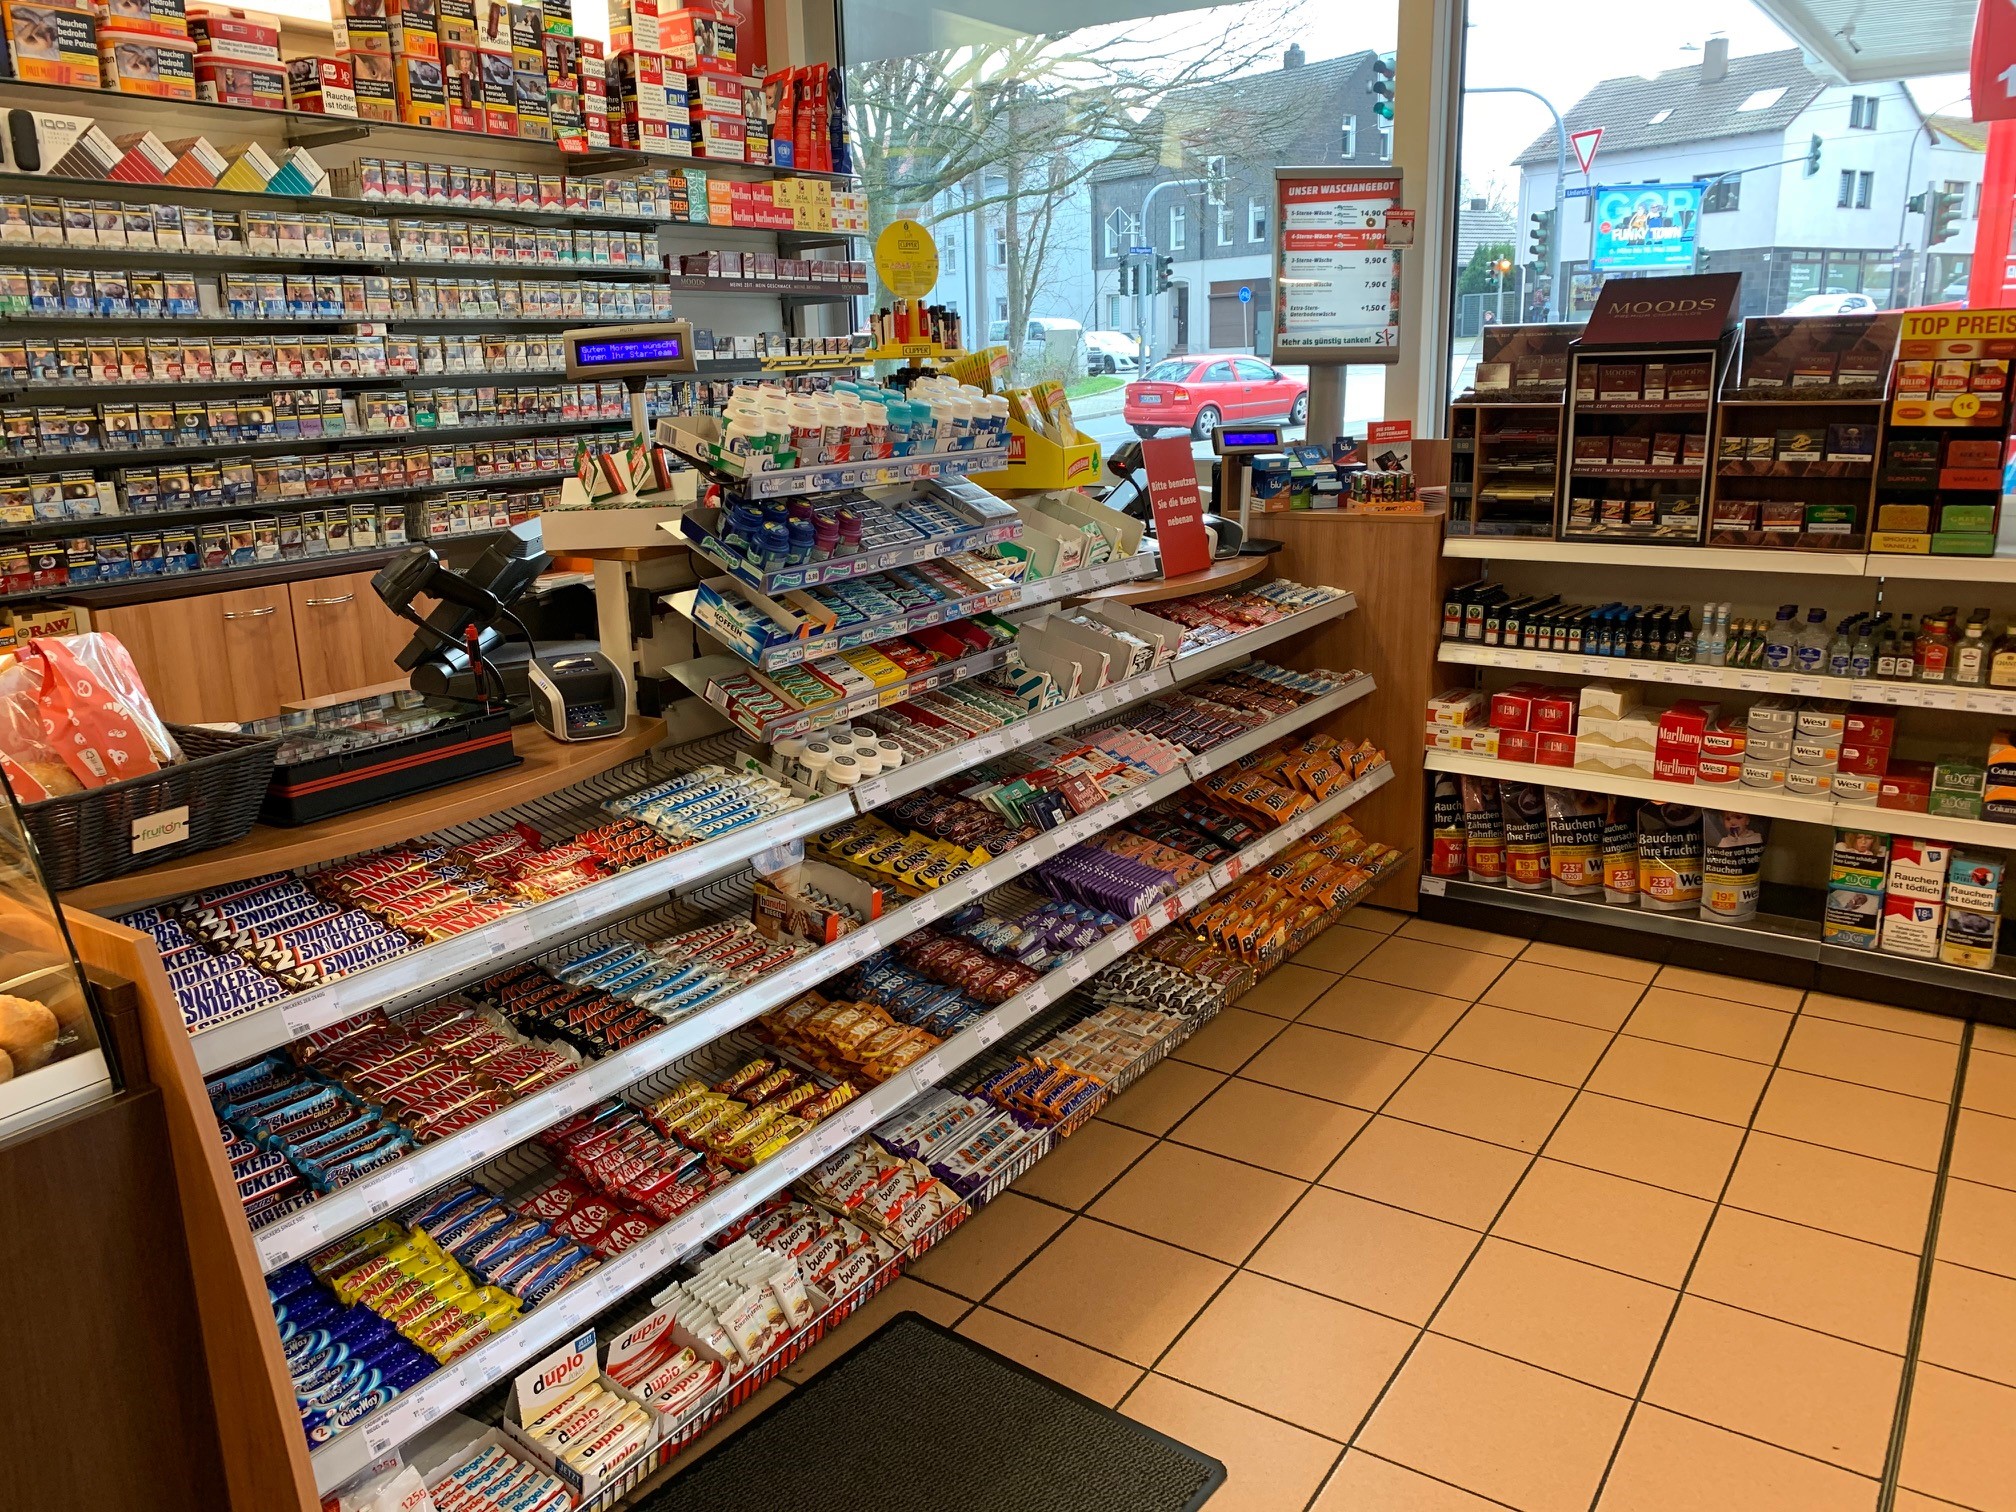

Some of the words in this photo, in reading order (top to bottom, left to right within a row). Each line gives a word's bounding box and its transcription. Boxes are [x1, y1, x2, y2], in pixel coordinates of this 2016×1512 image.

[57, 18, 87, 29] Rauchen
[58, 29, 86, 39] bedroht
[59, 38, 75, 47] Ihre
[158, 59, 183, 68] bedroht
[1288, 184, 1318, 196] UNSER
[1321, 182, 1395, 194] WASCHANGEBOT
[1612, 228, 1647, 241] FUNKY
[1651, 227, 1682, 238] TOWN
[1364, 257, 1381, 265] 9,90
[1364, 281, 1381, 289] 7,90
[1609, 298, 1716, 314] MOODS
[1909, 317, 1950, 335] TOP
[1956, 316, 2016, 334] PREIS
[610, 344, 638, 352] Morgen
[1314, 337, 1342, 346] günstig
[1344, 336, 1372, 344] tanken!
[630, 350, 672, 358] Star-Team
[1151, 482, 1167, 491] Bitte
[1168, 478, 1196, 489] benutzen
[1270, 480, 1281, 489] blu
[1158, 500, 1167, 509] Sie
[1169, 498, 1179, 508] die
[1180, 496, 1196, 505] Kasse
[1168, 515, 1193, 526] nebenan
[29, 618, 70, 636] RAW
[714, 612, 743, 637] KOFFEIN
[1659, 727, 1700, 744] Marlboro
[1707, 737, 1730, 747] West
[1655, 759, 1696, 776] Marlboro
[1702, 763, 1725, 773] West
[627, 777, 686, 803] BOUNTY
[659, 782, 721, 808] BOUNTY
[1837, 779, 1862, 790] West
[679, 789, 737, 817] BOUNTY
[691, 799, 748, 824] BOUNTY
[142, 821, 181, 841] fruiton
[820, 821, 858, 844] CORNY
[1467, 821, 1492, 829] Zähne
[1550, 819, 1595, 831] Rauchen
[842, 833, 879, 856] CORNY
[1507, 832, 1523, 841] Ihre
[1552, 833, 1572, 844] Ihre
[1639, 833, 1684, 844] Rauchen
[868, 842, 905, 865] CORNY
[893, 848, 932, 873] CORNY
[1640, 845, 1661, 857] Ihre
[1706, 856, 1736, 865] werden
[1738, 857, 1746, 865] oft
[1707, 847, 1732, 857] Kinder
[1734, 848, 1744, 856] von
[334, 850, 420, 886] TWIX
[1705, 864, 1742, 875] Rauchern
[352, 869, 436, 902] TWIX
[1890, 881, 1903, 889] ist
[1905, 883, 1940, 895] tödlich
[1894, 872, 1939, 886] Rauchen
[222, 880, 306, 917] SNICKERS
[378, 883, 459, 918] TWIX
[1134, 884, 1161, 915] Milka
[1951, 886, 1993, 899] Rauchen
[1961, 896, 1994, 908] tödlich
[236, 893, 318, 929] SNICKERS
[257, 902, 341, 940] SNICKERS
[764, 908, 782, 918] RIEGEL
[283, 910, 368, 950] SNICKERS
[1055, 923, 1076, 942] Milka
[1074, 927, 1095, 947] Milka
[256, 938, 280, 958] 2
[300, 922, 386, 960] SNICKERS
[272, 950, 296, 971] 2
[994, 972, 1019, 989] YES!
[568, 994, 614, 1026] Mars
[606, 1009, 652, 1045] Mars
[850, 1017, 879, 1038] YES!
[735, 1059, 766, 1083] LION
[758, 1069, 791, 1093] LION
[780, 1082, 815, 1109] LION
[618, 1158, 645, 1184] KitKat
[826, 1153, 851, 1176] bueno
[839, 1168, 862, 1193] bueno
[534, 1188, 572, 1217] KitKat
[259, 1226, 281, 1243] SNICKERS
[281, 1218, 296, 1231] SINGLE
[296, 1216, 305, 1224] 50G
[569, 1206, 607, 1238] KitKat
[749, 1215, 777, 1240] bueno
[436, 1216, 482, 1250] Knoppers
[777, 1224, 806, 1250] bueno
[806, 1241, 833, 1271] bueno
[343, 1255, 389, 1291] Nuts
[838, 1255, 866, 1285] bueno
[360, 1268, 403, 1303] Nuts
[620, 1312, 667, 1350] duplo
[533, 1352, 585, 1395] duplo
[338, 1395, 379, 1426] MilkyWay
[364, 1416, 384, 1429] CADBURY
[366, 1424, 381, 1435] RIEGEL
[381, 1419, 390, 1427] 49G
[557, 1406, 600, 1445] duplo
[582, 1422, 625, 1459] duplo
[372, 1459, 398, 1475] 125g
[454, 1455, 485, 1479] Riegel
[558, 1462, 581, 1483] JETZT
[465, 1466, 498, 1491] Riegel
[484, 1473, 516, 1497] Riegel
[401, 1489, 427, 1510] 125g
[498, 1482, 530, 1508] Riegel
